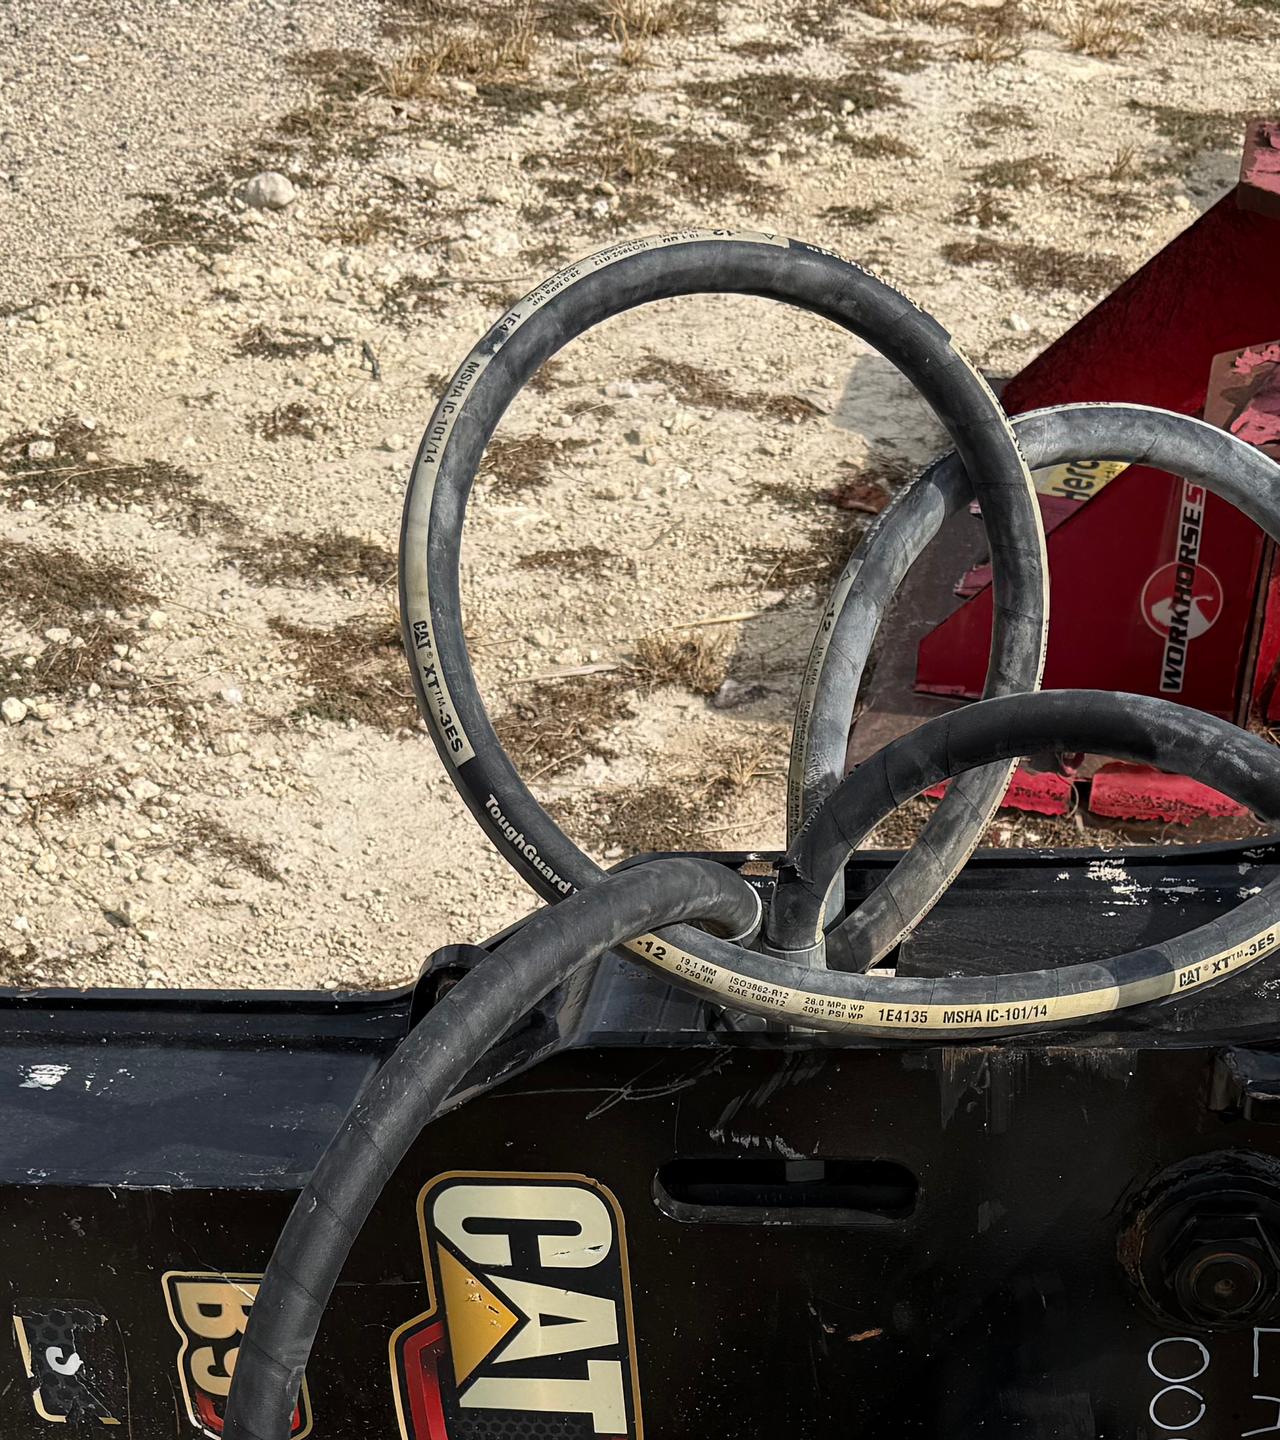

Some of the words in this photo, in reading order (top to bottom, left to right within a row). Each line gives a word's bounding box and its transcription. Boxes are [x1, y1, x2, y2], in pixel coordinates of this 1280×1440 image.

[448, 361, 481, 398] MSHA
[423, 400, 458, 463] IC-101/14
[1163, 505, 1203, 692] WORKHORSE
[413, 620, 432, 650] CAT
[675, 964, 702, 980] 0.750
[680, 956, 698, 969] 19.1
[700, 965, 718, 977] MM
[1178, 967, 1203, 989] CAT
[727, 985, 748, 997] SAE
[750, 992, 786, 1008] 100R12
[849, 1003, 866, 1012] WP
[827, 1009, 845, 1019] PSI
[847, 1012, 864, 1021] WP
[877, 1007, 928, 1025] 1E4135
[942, 1008, 984, 1025] MSHA
[986, 1004, 1048, 1024] IC-101/14
[433, 1185, 629, 1435] CAT
